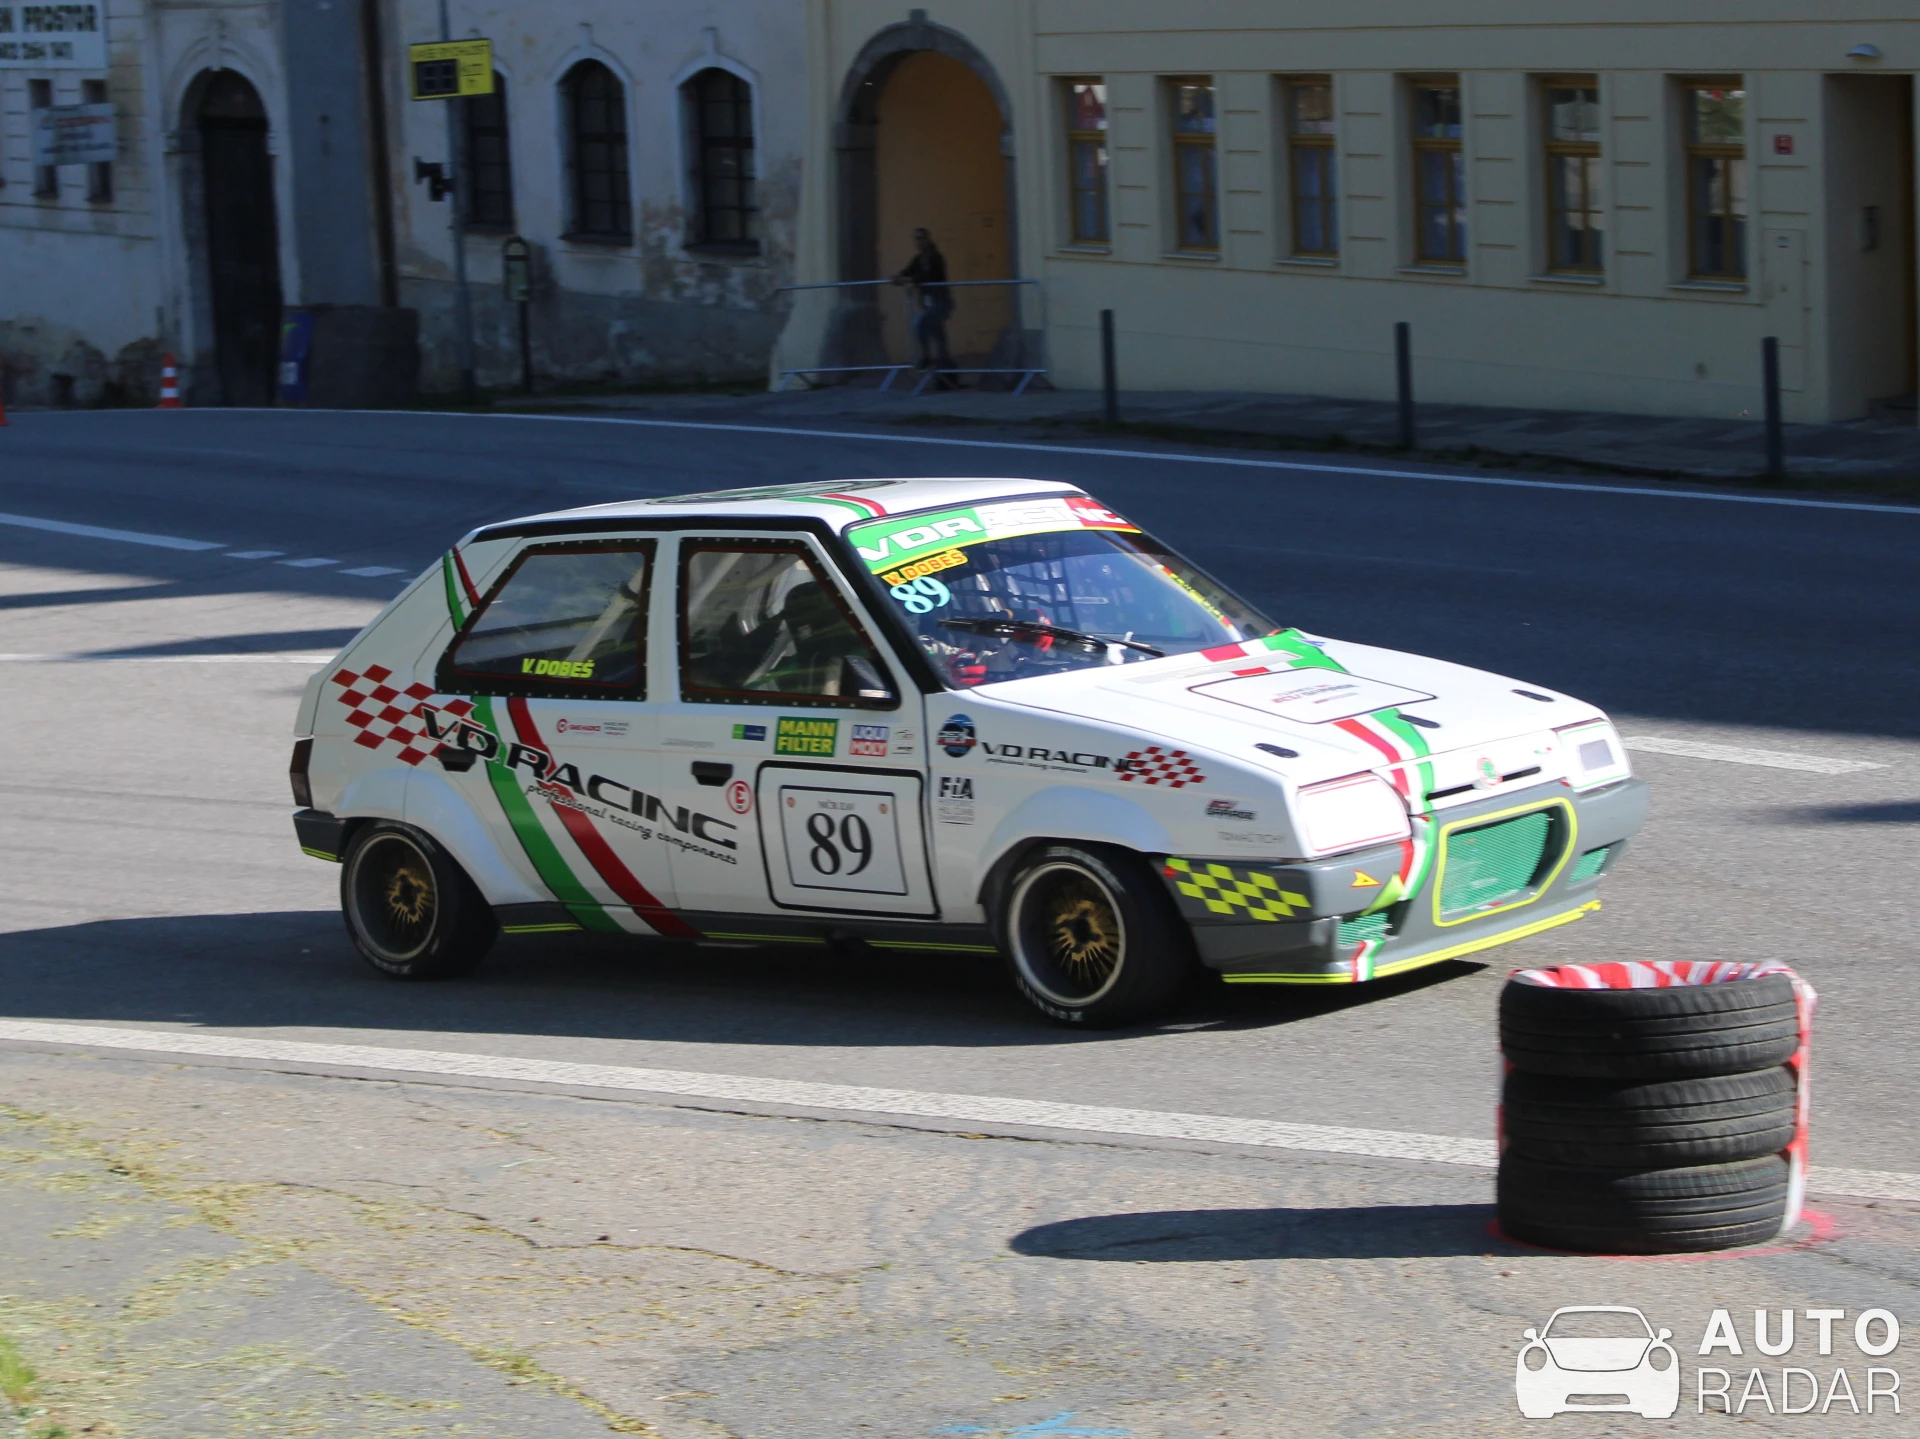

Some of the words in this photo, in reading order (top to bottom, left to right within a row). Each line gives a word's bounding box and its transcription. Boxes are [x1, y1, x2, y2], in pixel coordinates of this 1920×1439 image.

[890, 577, 951, 614] 89
[780, 720, 834, 736] MANN
[854, 727, 888, 740] LIQUI
[777, 736, 833, 753] FILTER
[851, 742, 886, 756] MOLY
[526, 784, 607, 819] professional
[609, 812, 653, 840] racing
[656, 831, 738, 865] components
[806, 812, 873, 876] 89
